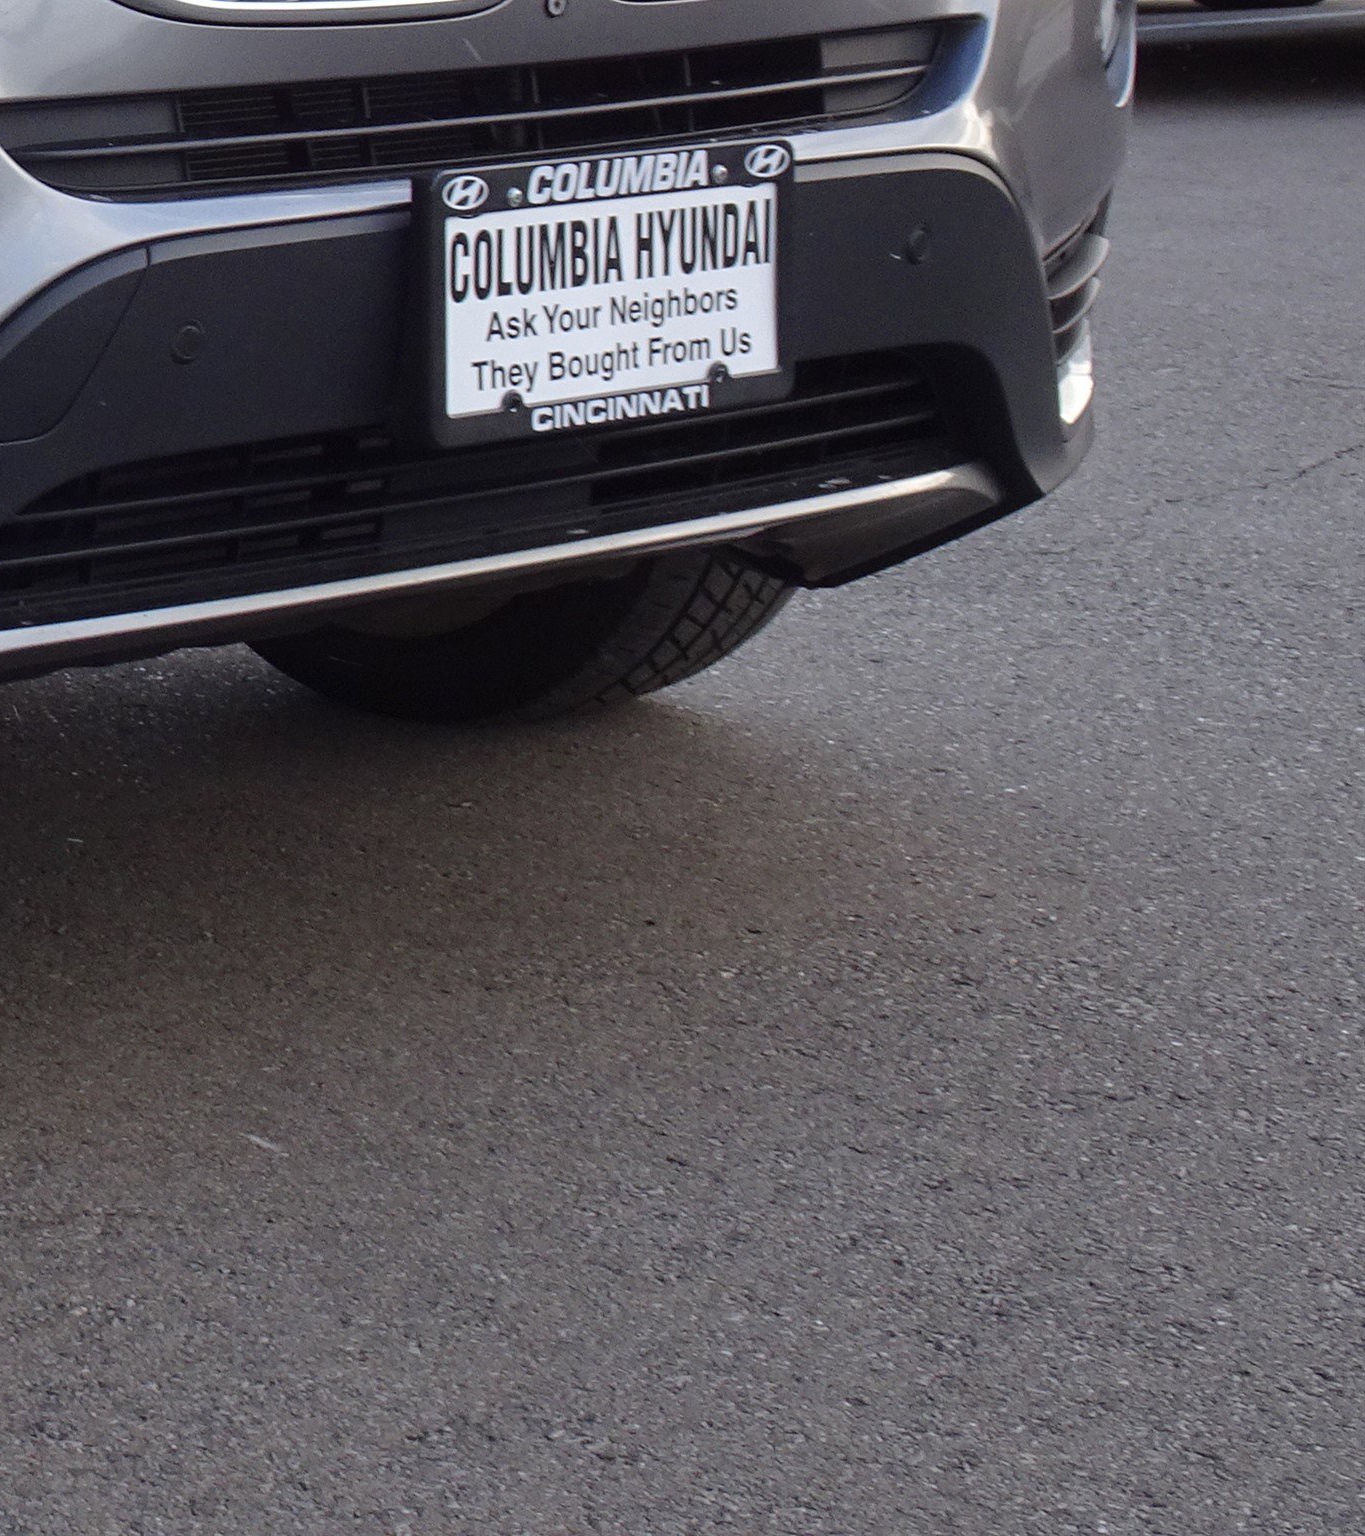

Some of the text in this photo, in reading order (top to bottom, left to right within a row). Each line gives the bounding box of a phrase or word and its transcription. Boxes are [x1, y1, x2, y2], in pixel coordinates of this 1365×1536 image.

[527, 150, 709, 204] COLUMBIA
[450, 197, 772, 303] COLUMBIA HYUNDAI
[485, 287, 739, 342] Ask Your Neighbors
[471, 326, 752, 393] They Bought From Us
[532, 385, 709, 431] CINCINNATI
